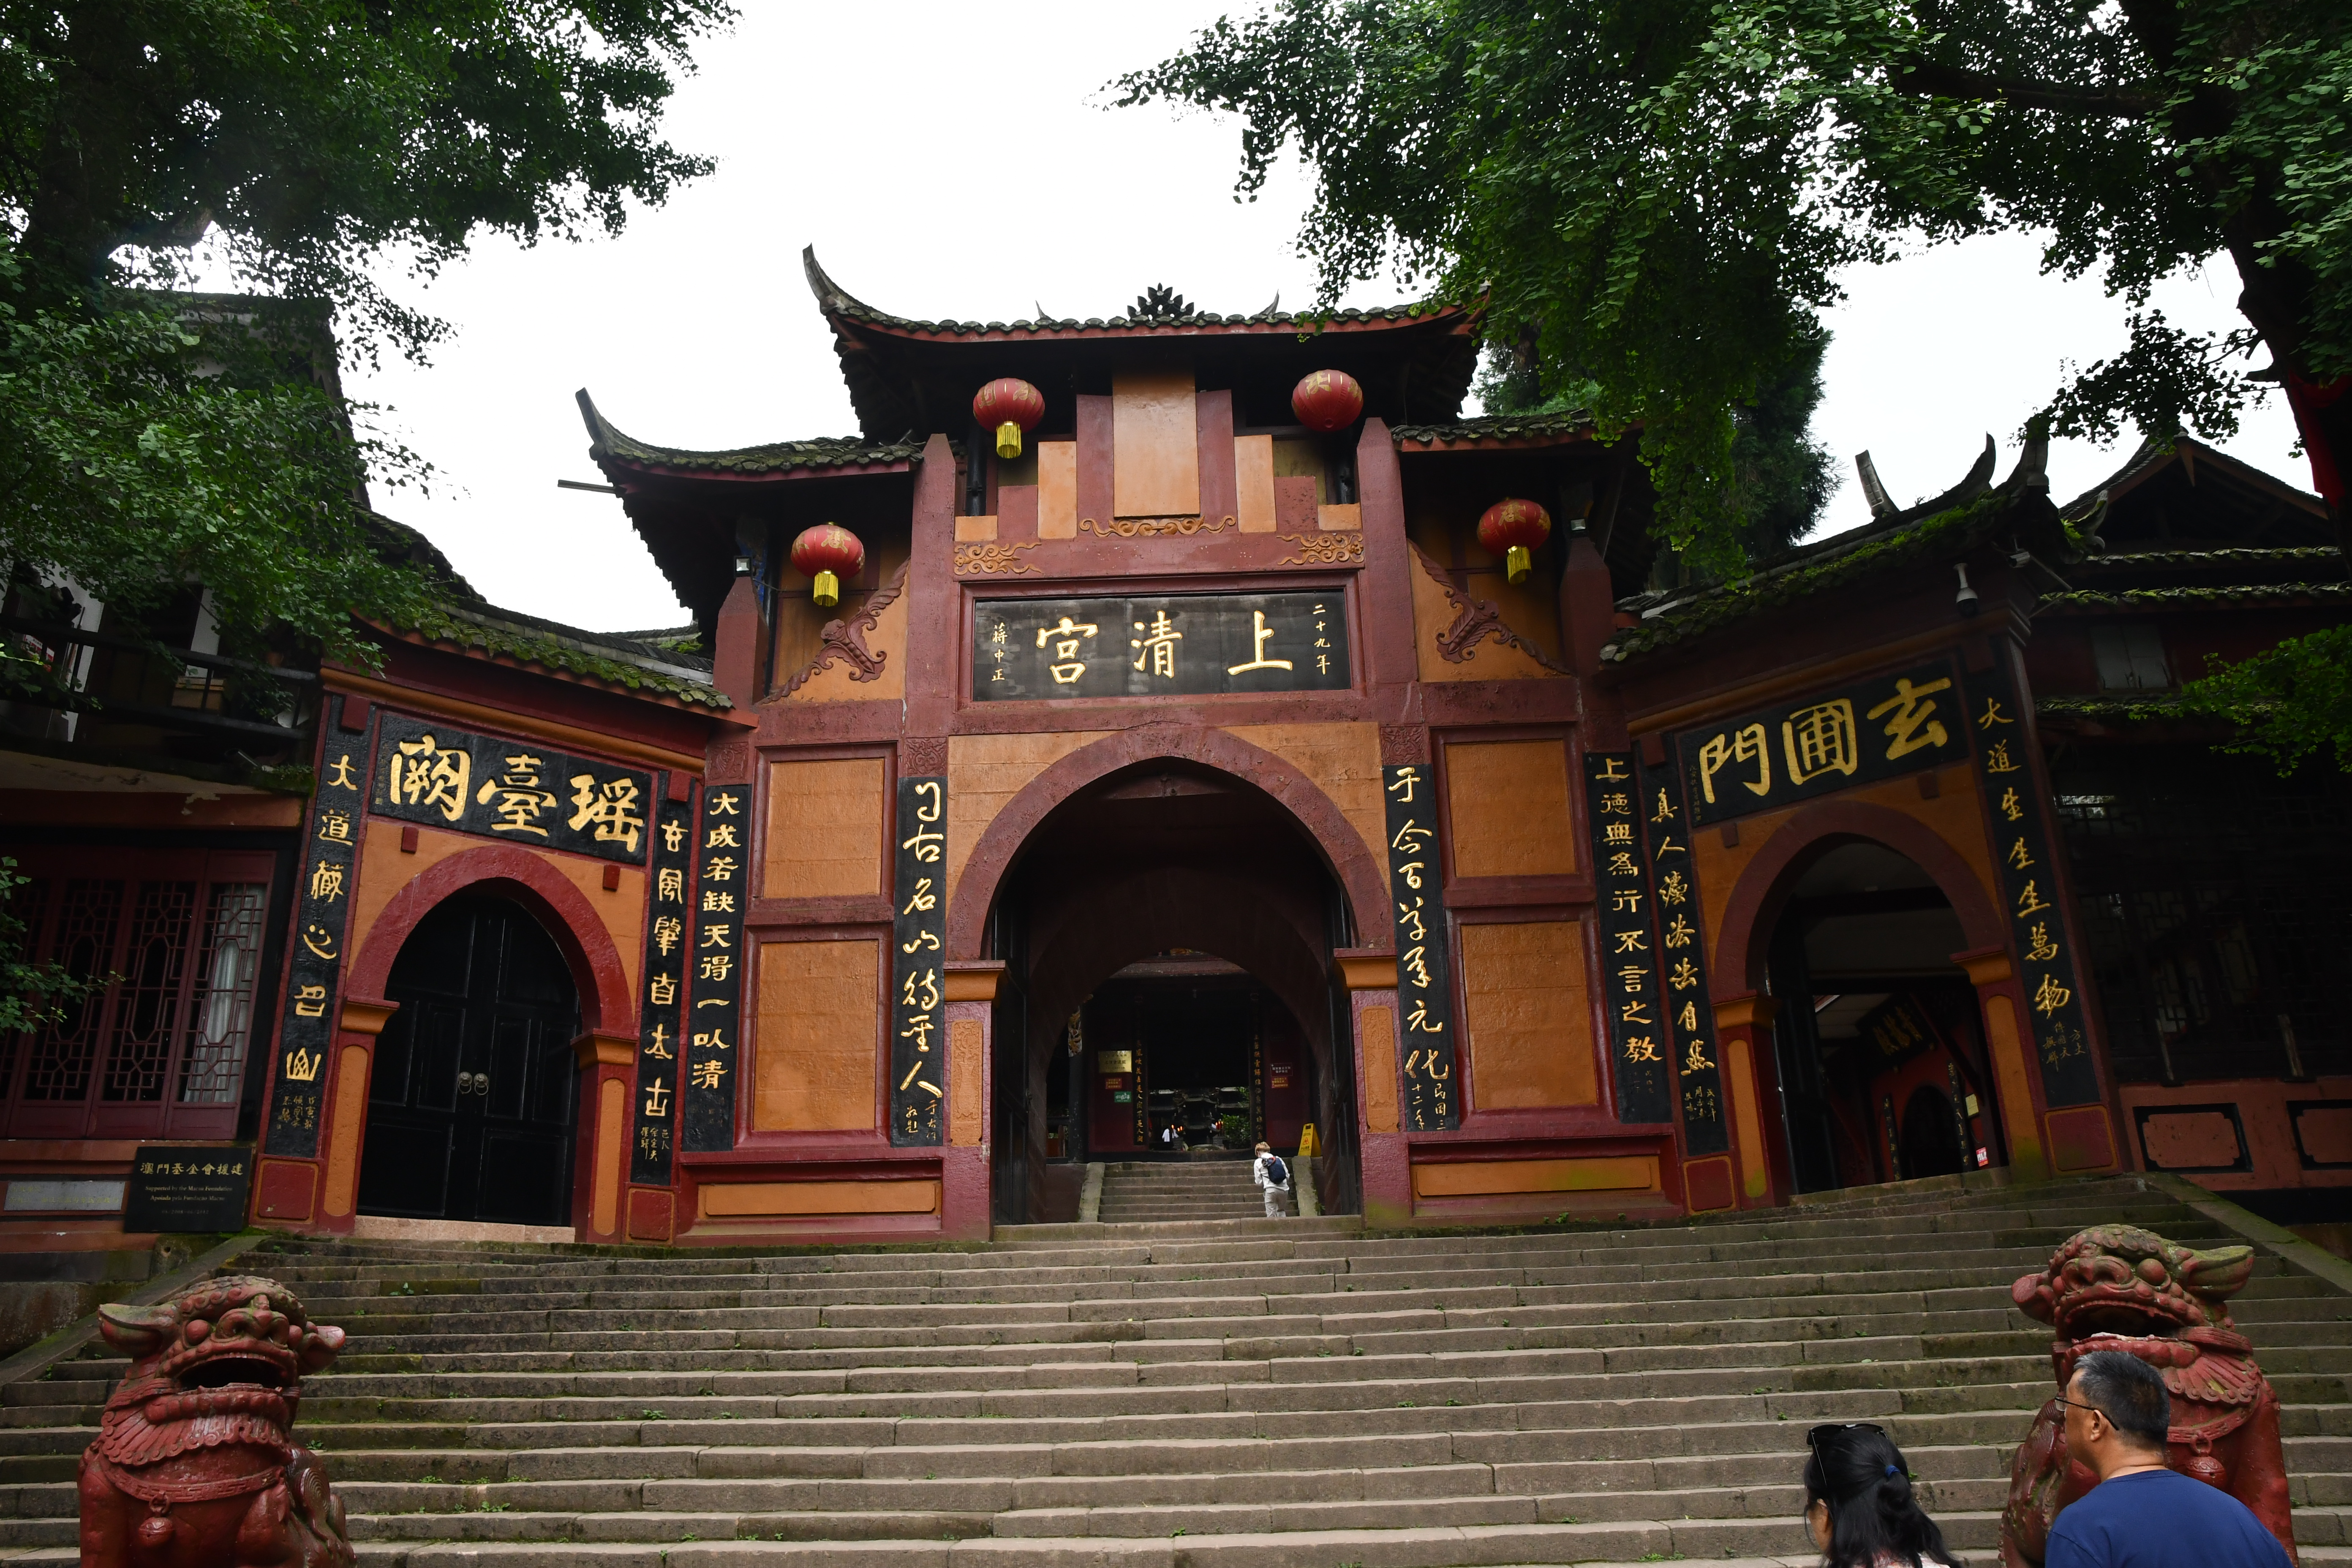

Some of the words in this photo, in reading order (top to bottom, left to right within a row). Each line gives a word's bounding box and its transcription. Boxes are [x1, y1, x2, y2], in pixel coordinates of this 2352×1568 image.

[1312, 604, 1331, 675] 二十九年
[140, 1162, 244, 1176] 澳門基金會援建
